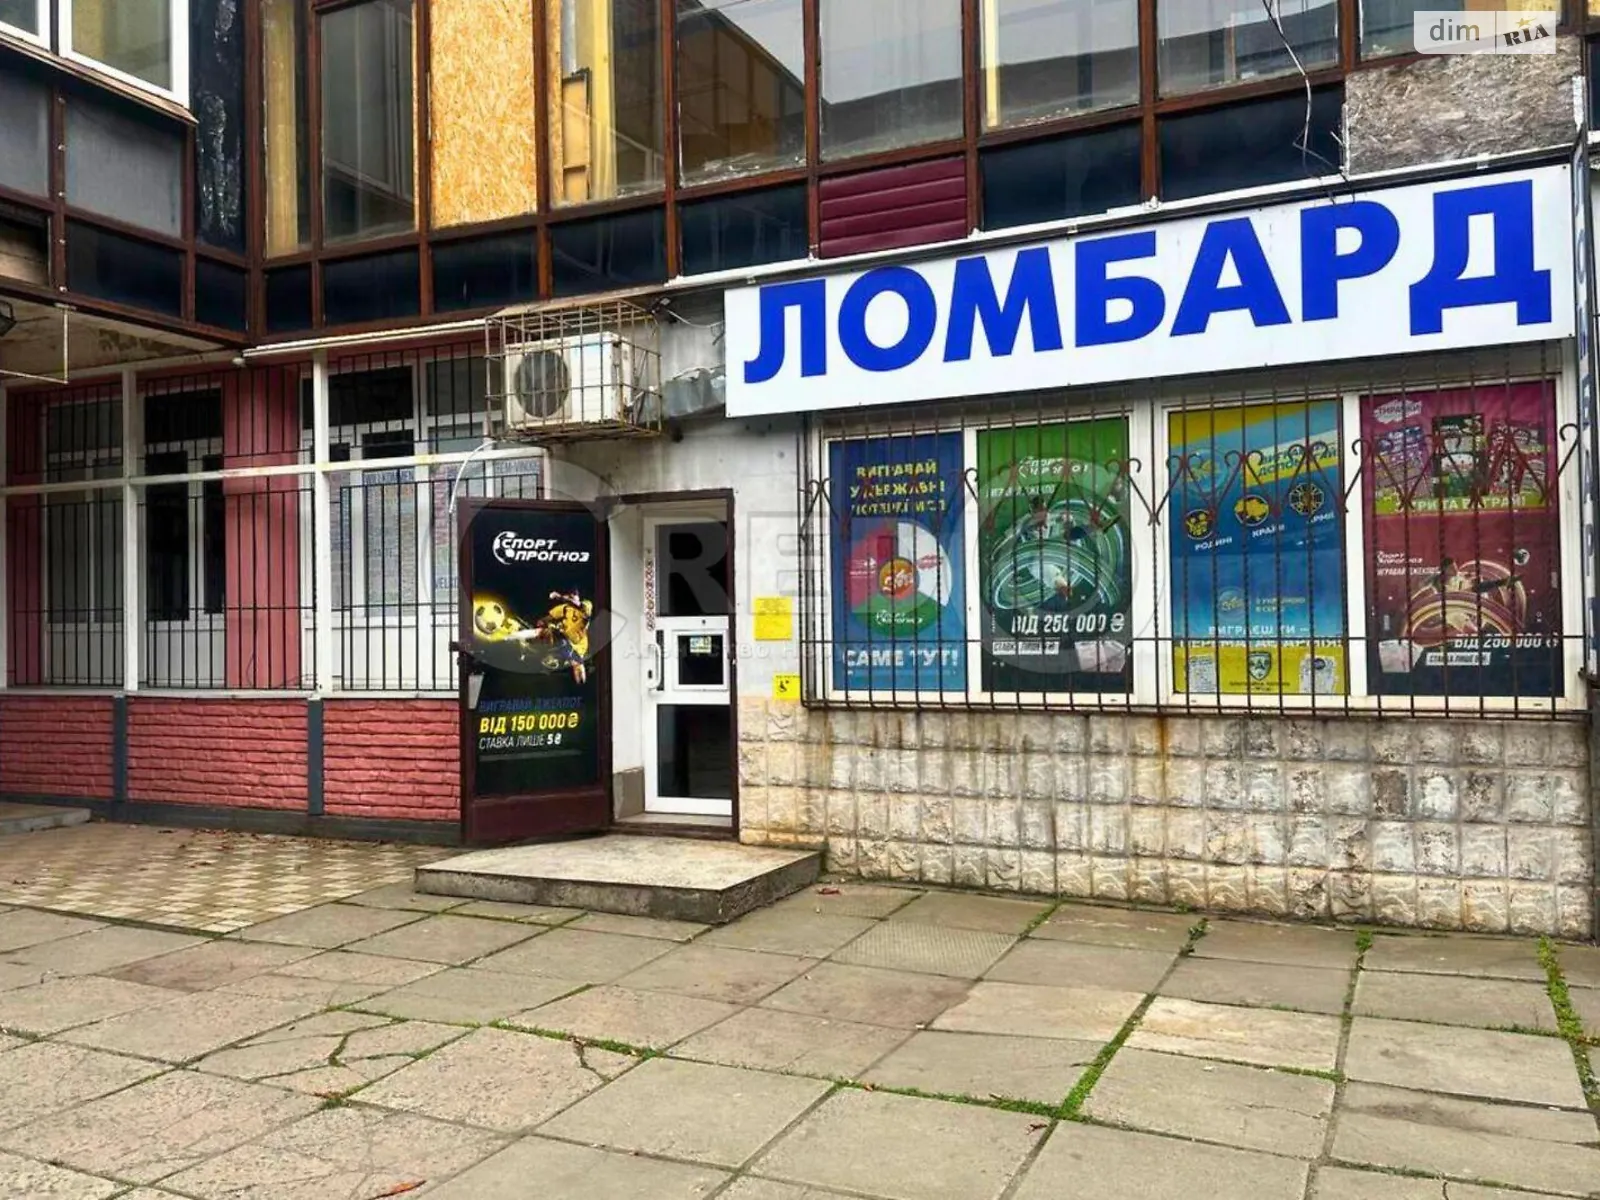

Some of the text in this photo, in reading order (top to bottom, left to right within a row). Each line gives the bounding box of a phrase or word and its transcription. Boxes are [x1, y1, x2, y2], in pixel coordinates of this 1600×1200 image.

[744, 179, 1552, 385] ЛОМБАРД
[501, 539, 558, 550] СПОРТ
[515, 550, 590, 562] ПРОГНОЗ
[1043, 613, 1070, 633] 250
[1075, 613, 1107, 633] 000
[842, 649, 905, 668] САМЕ
[909, 649, 959, 667] ТУТ!
[480, 717, 506, 735] ВІД
[511, 714, 535, 732] 150
[479, 736, 514, 749] СТАВКА
